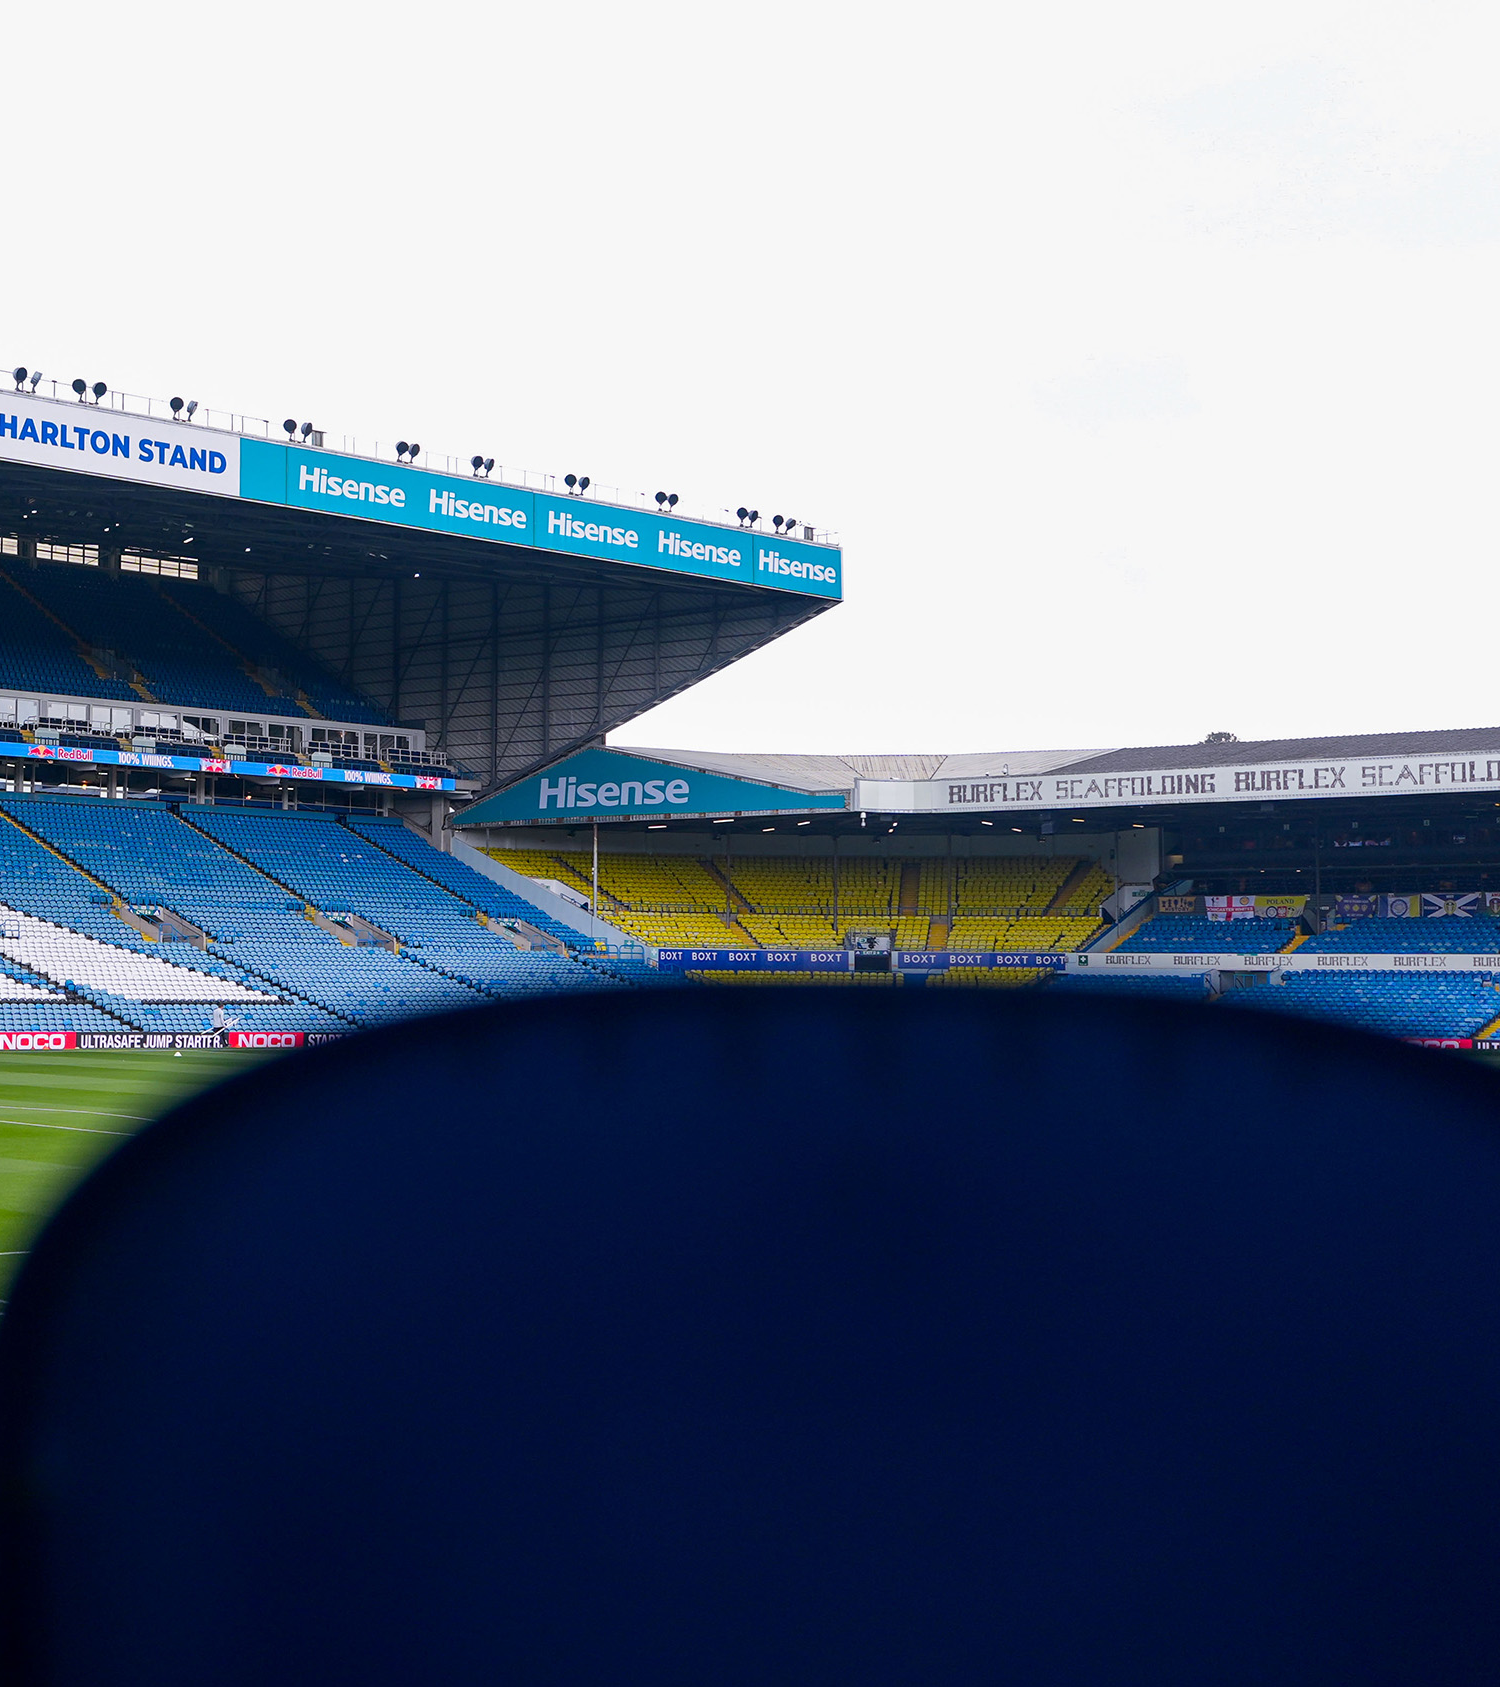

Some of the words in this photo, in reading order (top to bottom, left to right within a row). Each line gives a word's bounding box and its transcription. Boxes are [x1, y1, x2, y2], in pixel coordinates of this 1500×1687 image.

[138, 438, 228, 474] STAND
[299, 465, 406, 508] Hisense
[429, 488, 527, 529] Hisense
[547, 510, 639, 548] Hisense
[658, 530, 741, 567] Hisense
[758, 549, 836, 584] Hisense
[118, 752, 139, 765] 100%
[344, 770, 363, 781] 100%
[1234, 766, 1346, 792] BURFLEX
[539, 776, 689, 810] Hisense
[949, 781, 1043, 804] BURFLEX
[1056, 773, 1216, 799] SCAFFOLDING
[660, 952, 683, 961] BOXT
[691, 952, 718, 961] BOXT
[729, 952, 757, 962] BOXT
[767, 953, 797, 962] BOXT
[810, 954, 842, 963] BOXT
[903, 954, 936, 964] BOXT
[950, 955, 982, 964] BOXT
[996, 955, 1029, 965] BOXT
[1035, 956, 1065, 965] BOXT
[1105, 956, 1151, 965] BURFLEX
[1173, 956, 1221, 966] BURFLEX
[1244, 956, 1293, 966] BURFLEX
[1317, 956, 1368, 967] BURFLEX
[1393, 956, 1447, 967] BURFLEX
[0, 1033, 65, 1050] NOCO
[81, 1034, 141, 1049] ULTRASAFE
[143, 1034, 172, 1049] JUMP
[238, 1034, 296, 1047] NOCO
